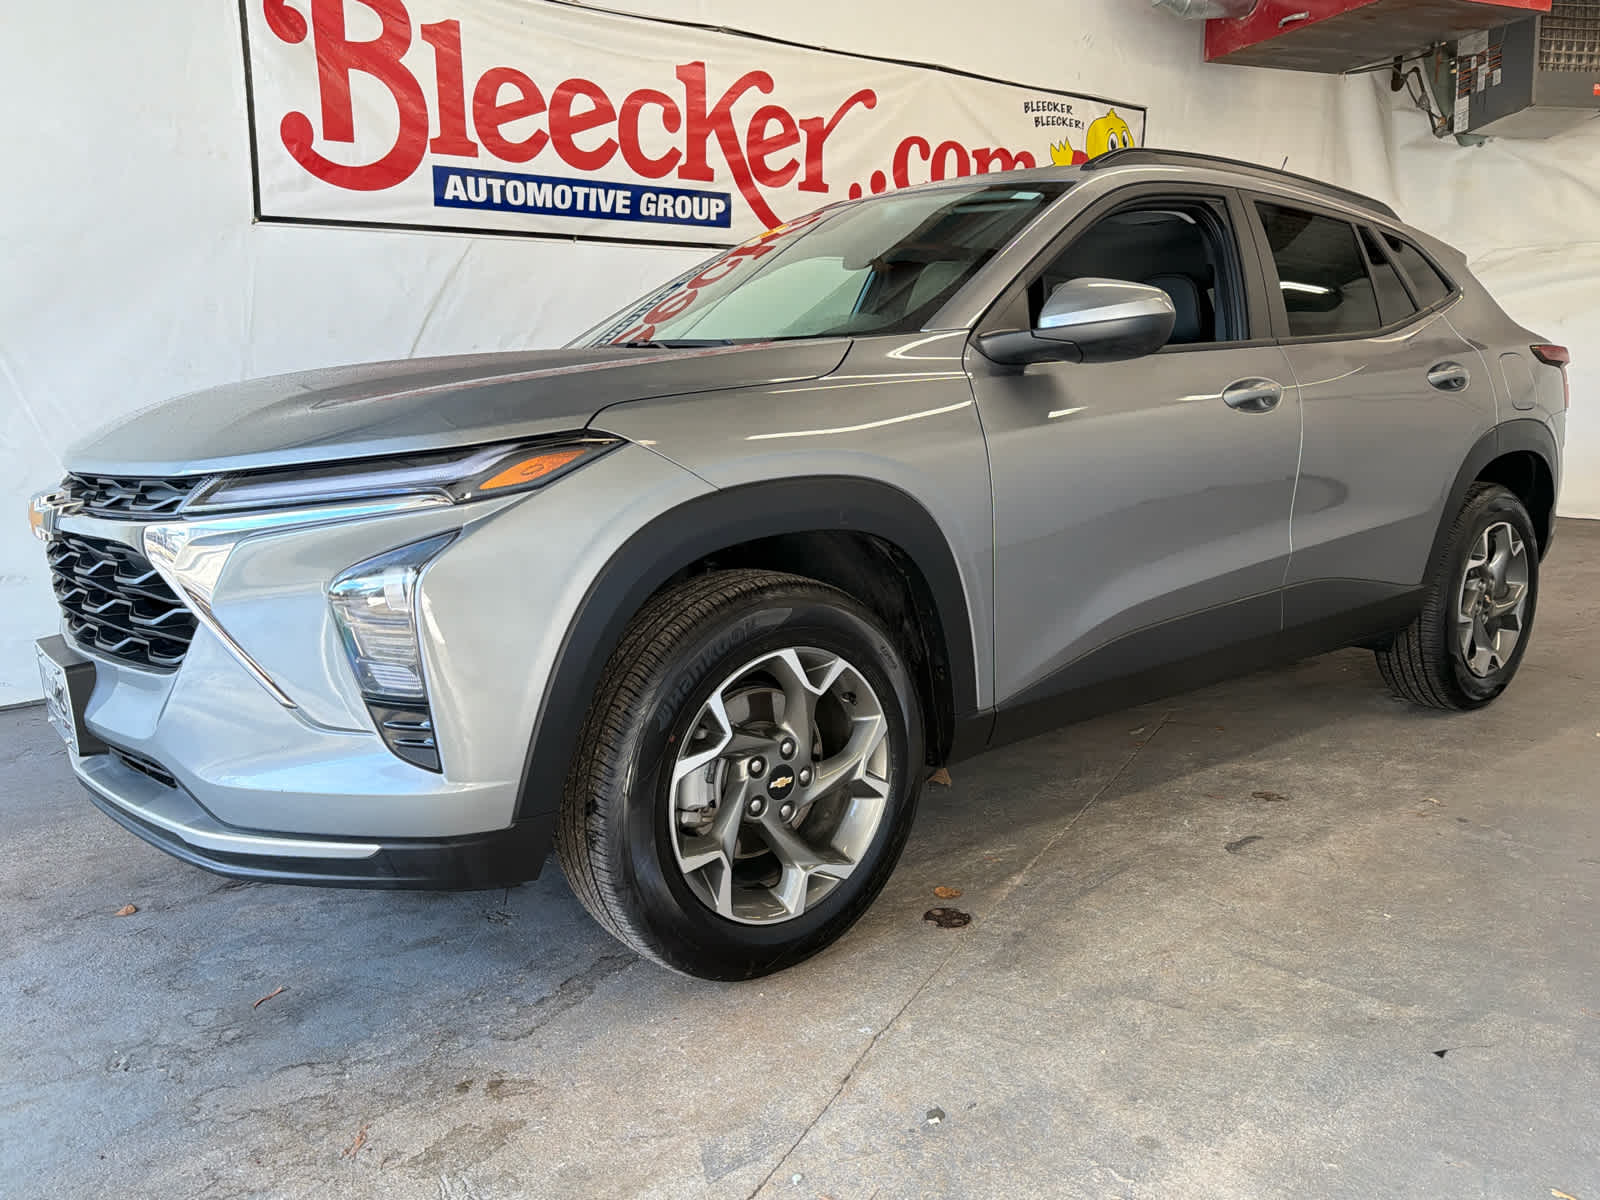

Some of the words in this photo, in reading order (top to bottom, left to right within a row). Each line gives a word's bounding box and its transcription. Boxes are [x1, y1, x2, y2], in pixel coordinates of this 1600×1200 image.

[1024, 101, 1073, 115] BLEECKER
[1034, 115, 1085, 130] BLEECKER!
[444, 175, 631, 215] AUTOMOTIVE
[639, 193, 726, 221] GROUP
